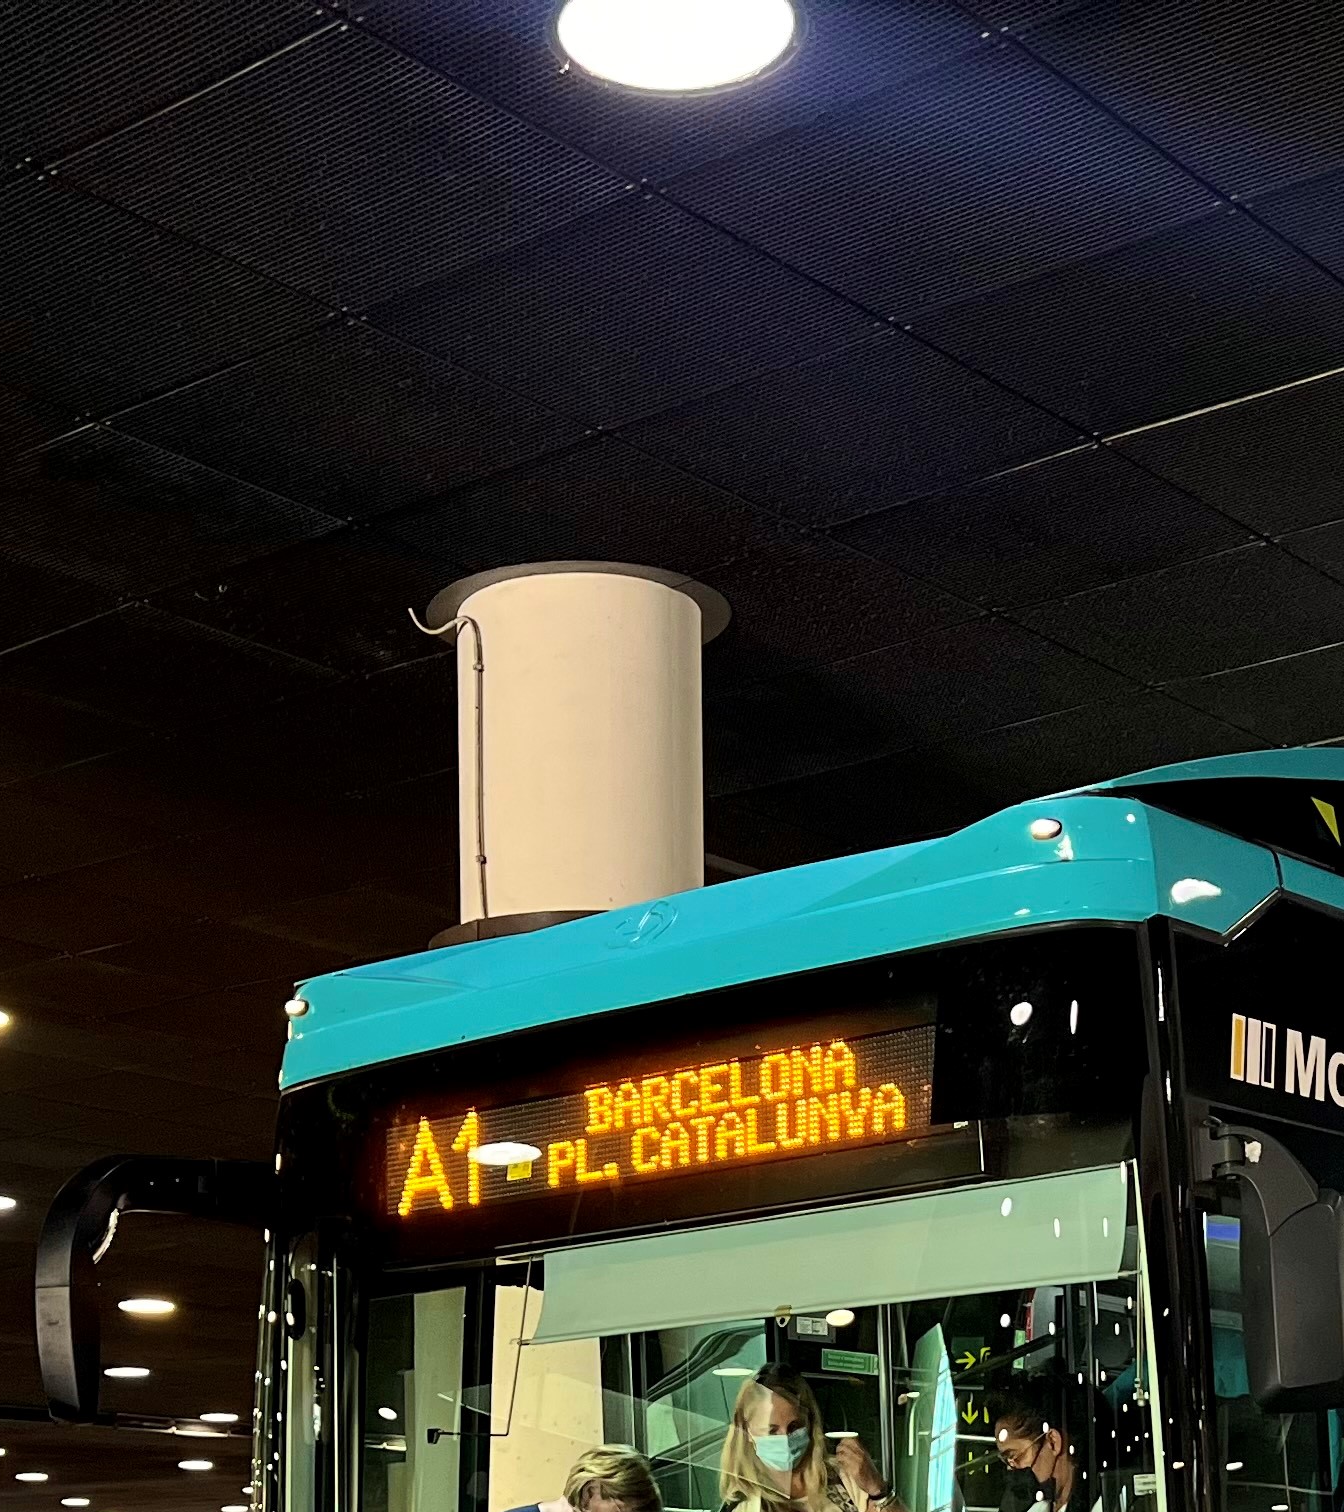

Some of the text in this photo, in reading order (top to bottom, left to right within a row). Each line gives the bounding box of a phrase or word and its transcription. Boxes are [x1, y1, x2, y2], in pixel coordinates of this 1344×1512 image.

[547, 1082, 906, 1189] PL. CATALUNYA
[584, 1040, 856, 1134] BARCELONA
[397, 1110, 482, 1217] A1
